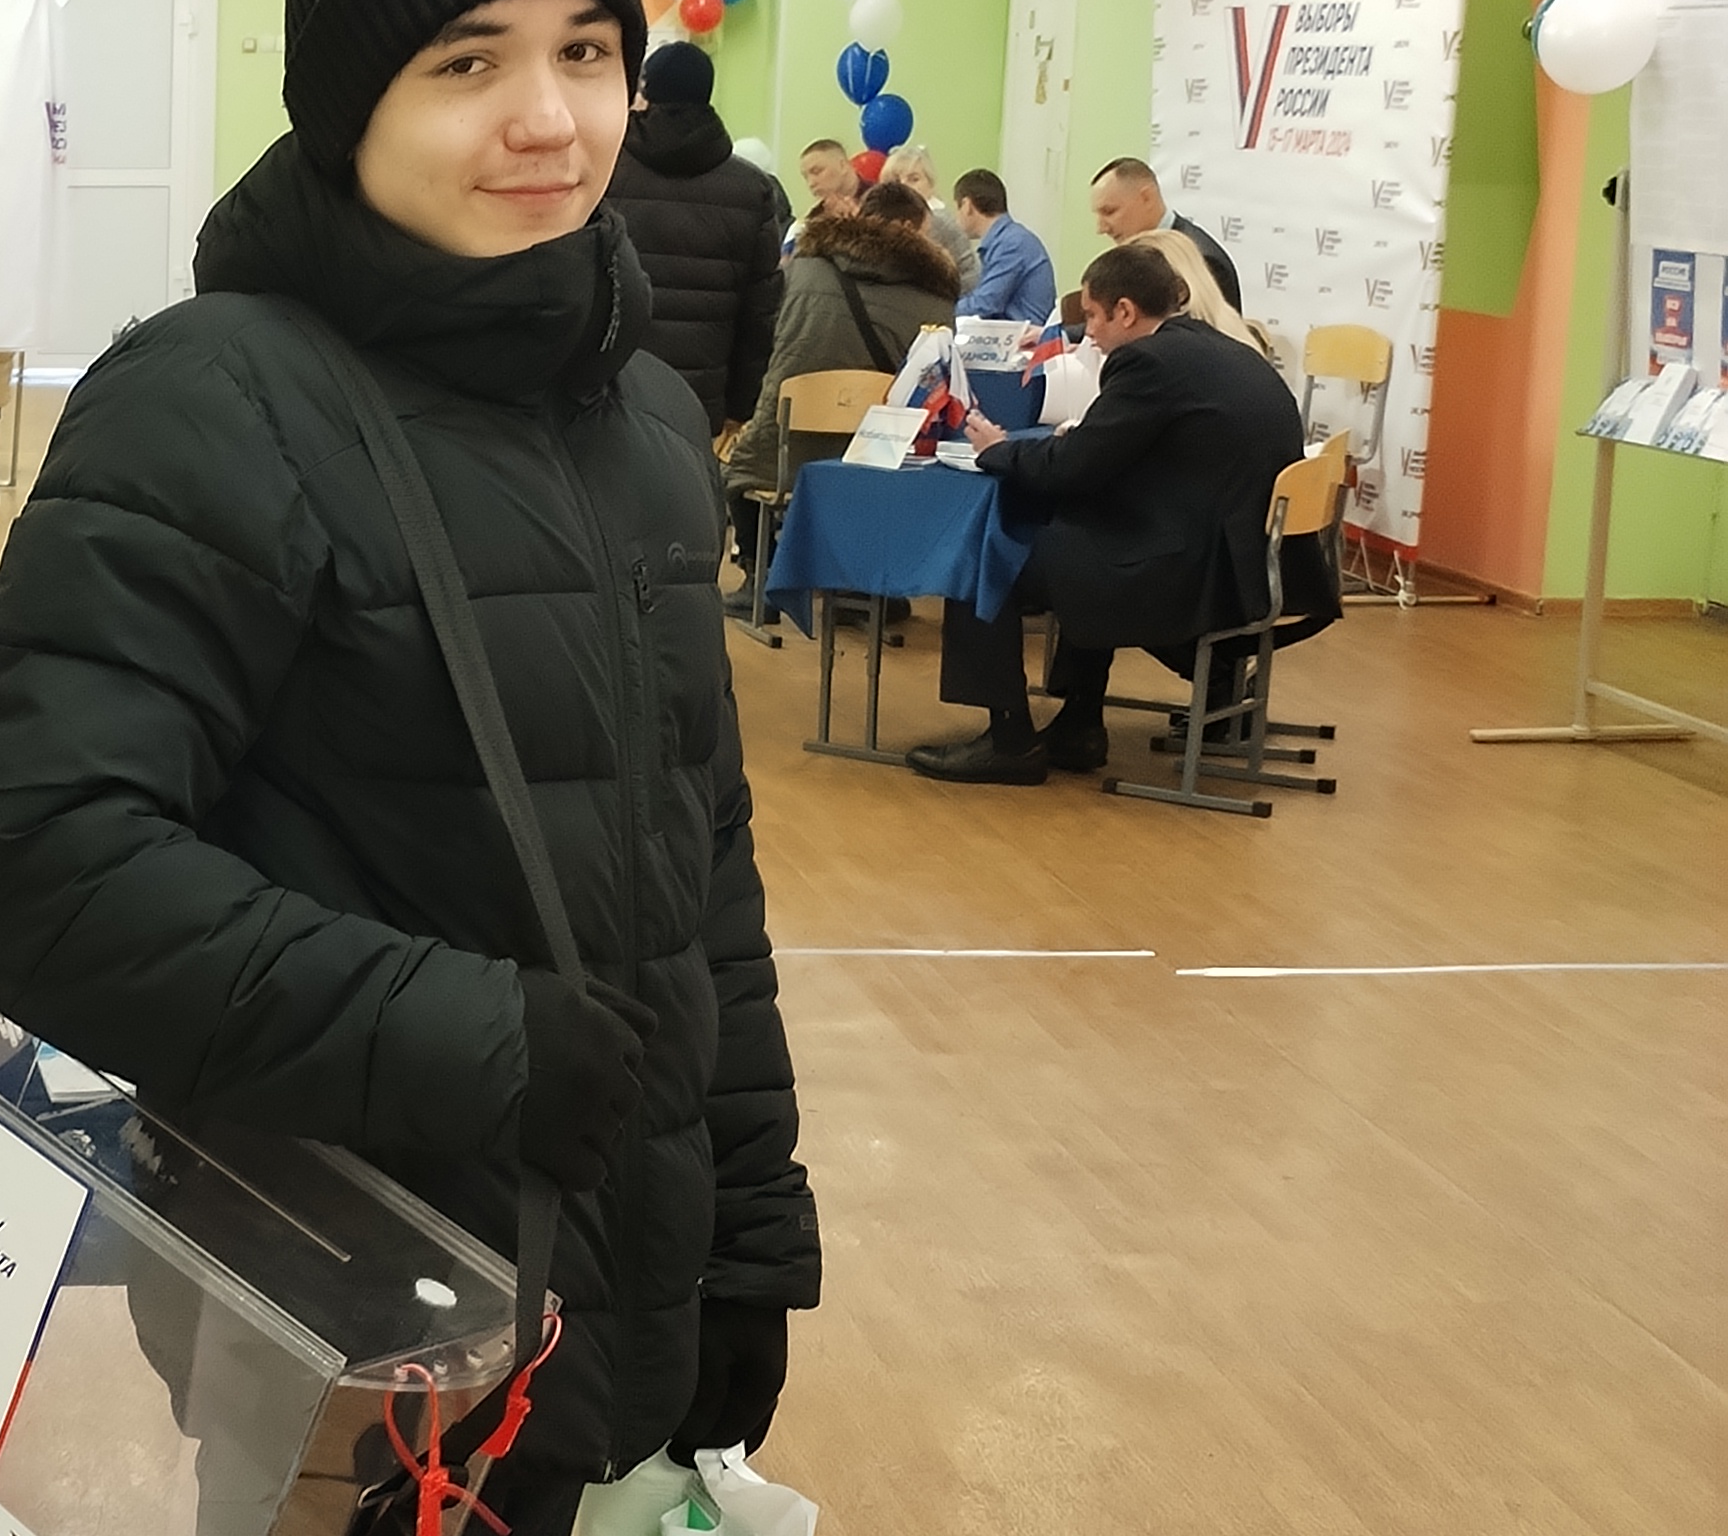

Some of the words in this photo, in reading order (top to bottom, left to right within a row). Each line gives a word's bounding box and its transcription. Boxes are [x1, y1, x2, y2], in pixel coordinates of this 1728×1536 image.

[1293, 1, 1361, 34] ВЫБОРЫ
[1282, 45, 1374, 81] ПРЕЗИДЕНТА
[1272, 87, 1332, 118] РОССИИ
[1004, 333, 1014, 347] 5
